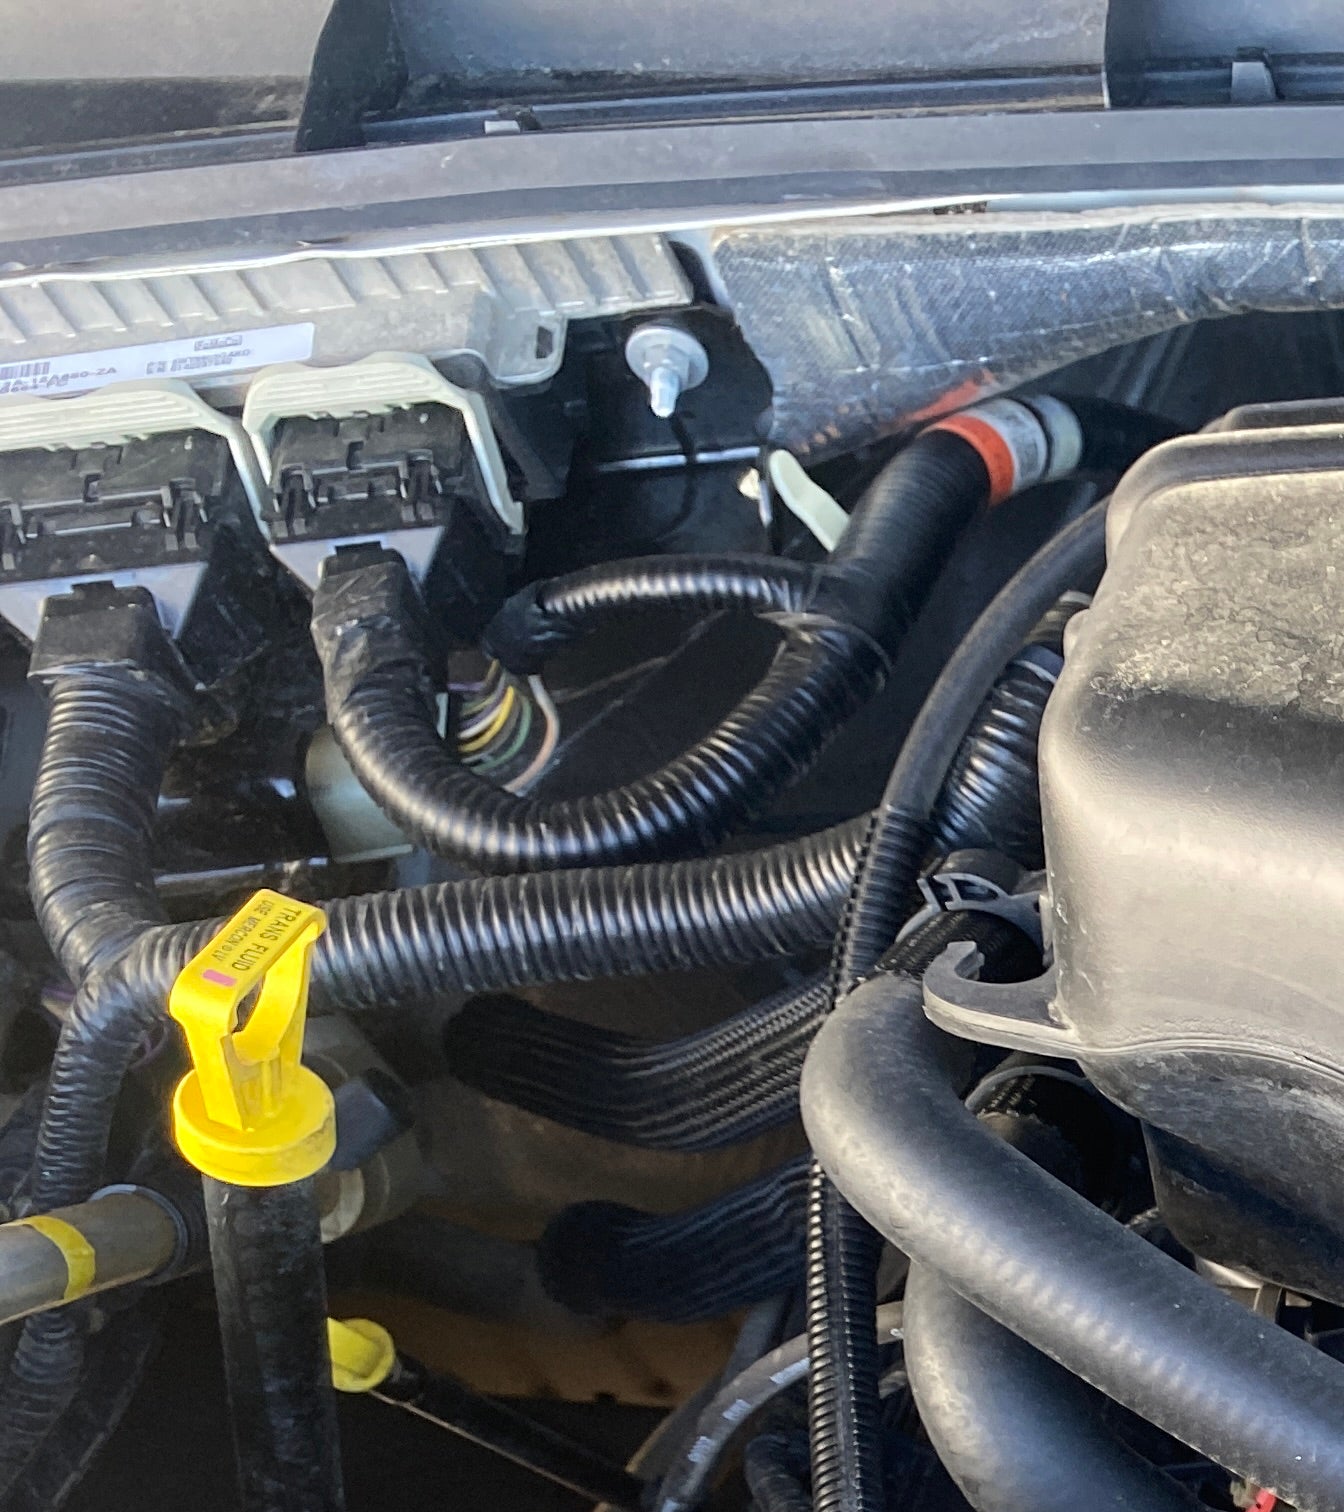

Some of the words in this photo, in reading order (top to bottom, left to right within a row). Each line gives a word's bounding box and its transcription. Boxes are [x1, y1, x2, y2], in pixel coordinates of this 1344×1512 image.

[254, 900, 273, 915] USE
[259, 907, 302, 941] TRANS
[232, 943, 269, 971] FLUID
